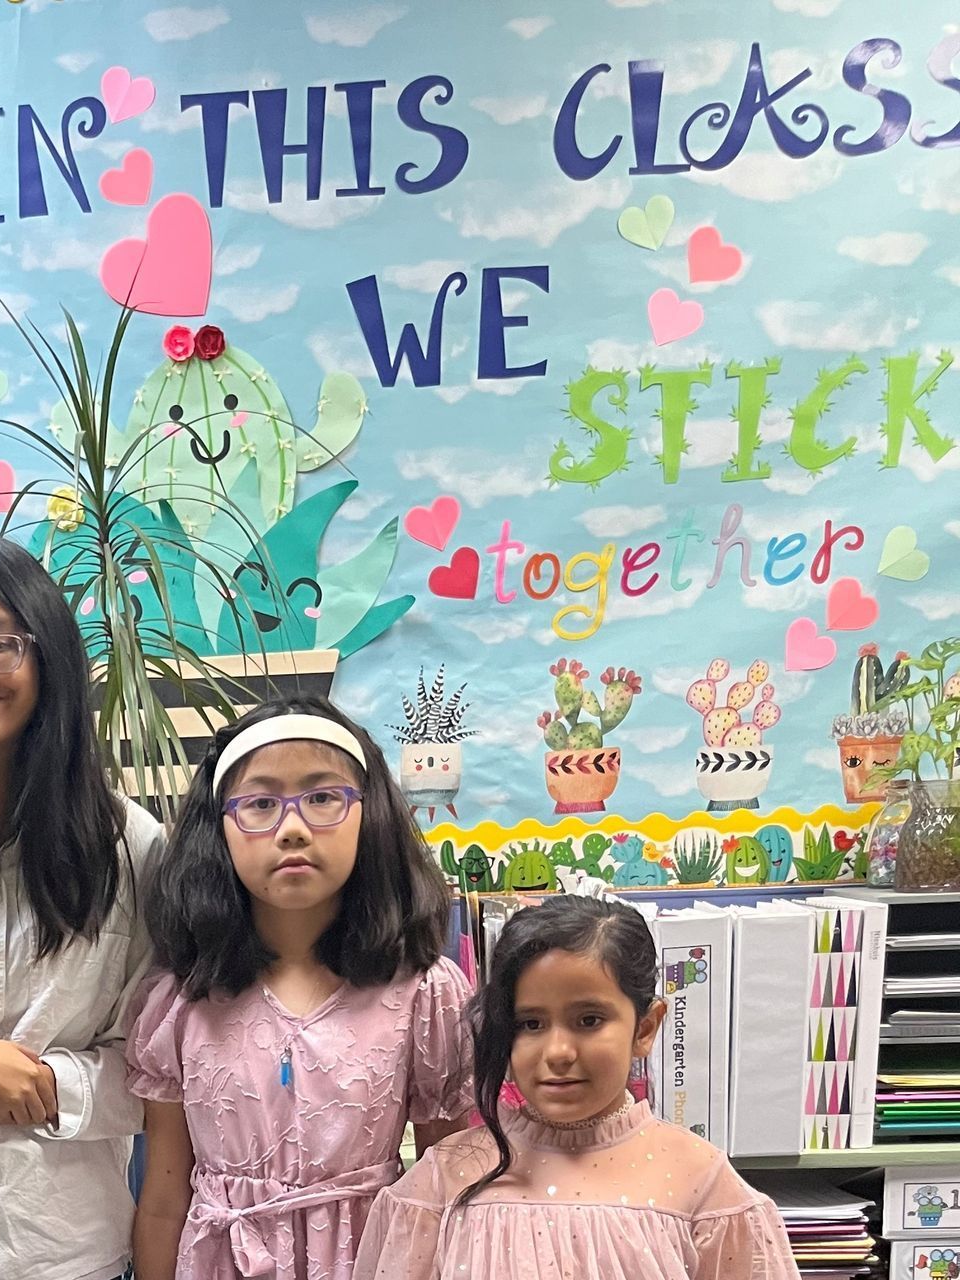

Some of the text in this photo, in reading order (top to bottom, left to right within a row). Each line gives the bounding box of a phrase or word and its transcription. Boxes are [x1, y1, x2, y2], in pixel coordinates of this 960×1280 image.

[180, 75, 469, 209] THIS
[553, 33, 960, 181] CLASS
[346, 265, 550, 388] WE
[548, 349, 959, 491] STICK
[486, 503, 865, 641] together
[672, 995, 687, 1127] Kindergarten Phon
